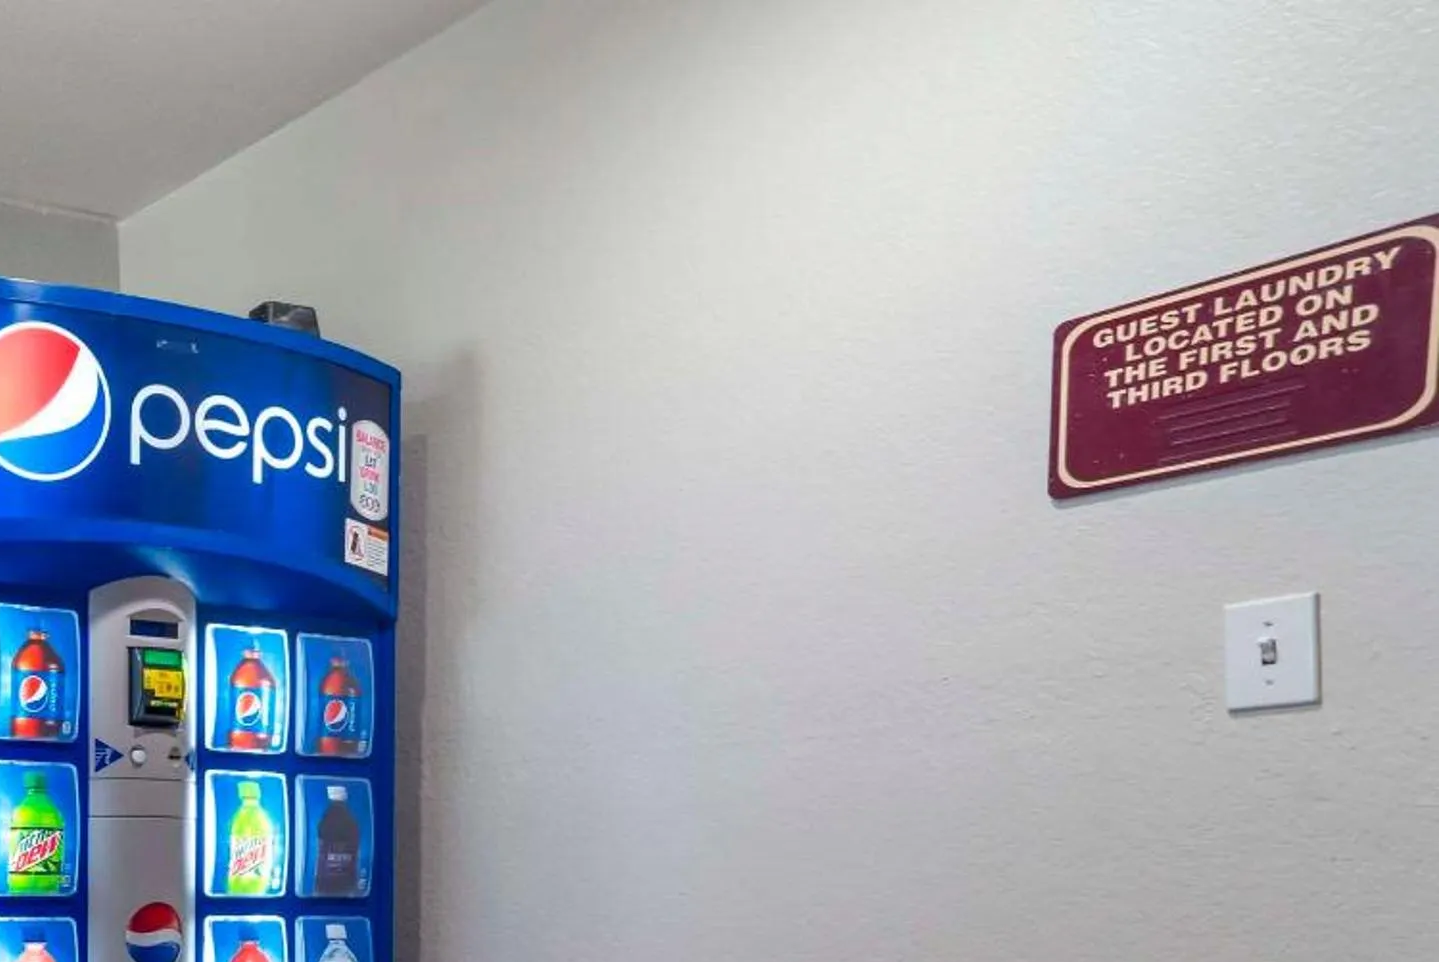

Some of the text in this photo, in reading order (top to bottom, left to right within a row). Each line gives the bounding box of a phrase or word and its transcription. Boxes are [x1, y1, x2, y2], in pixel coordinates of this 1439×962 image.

[1093, 246, 1401, 348] GUEST LAUNDRY
[1125, 284, 1354, 363] LOCATED ON
[1103, 303, 1380, 389] THE FIRST AND
[1106, 329, 1373, 410] THIRD FLOORS
[129, 383, 348, 485] pepsi
